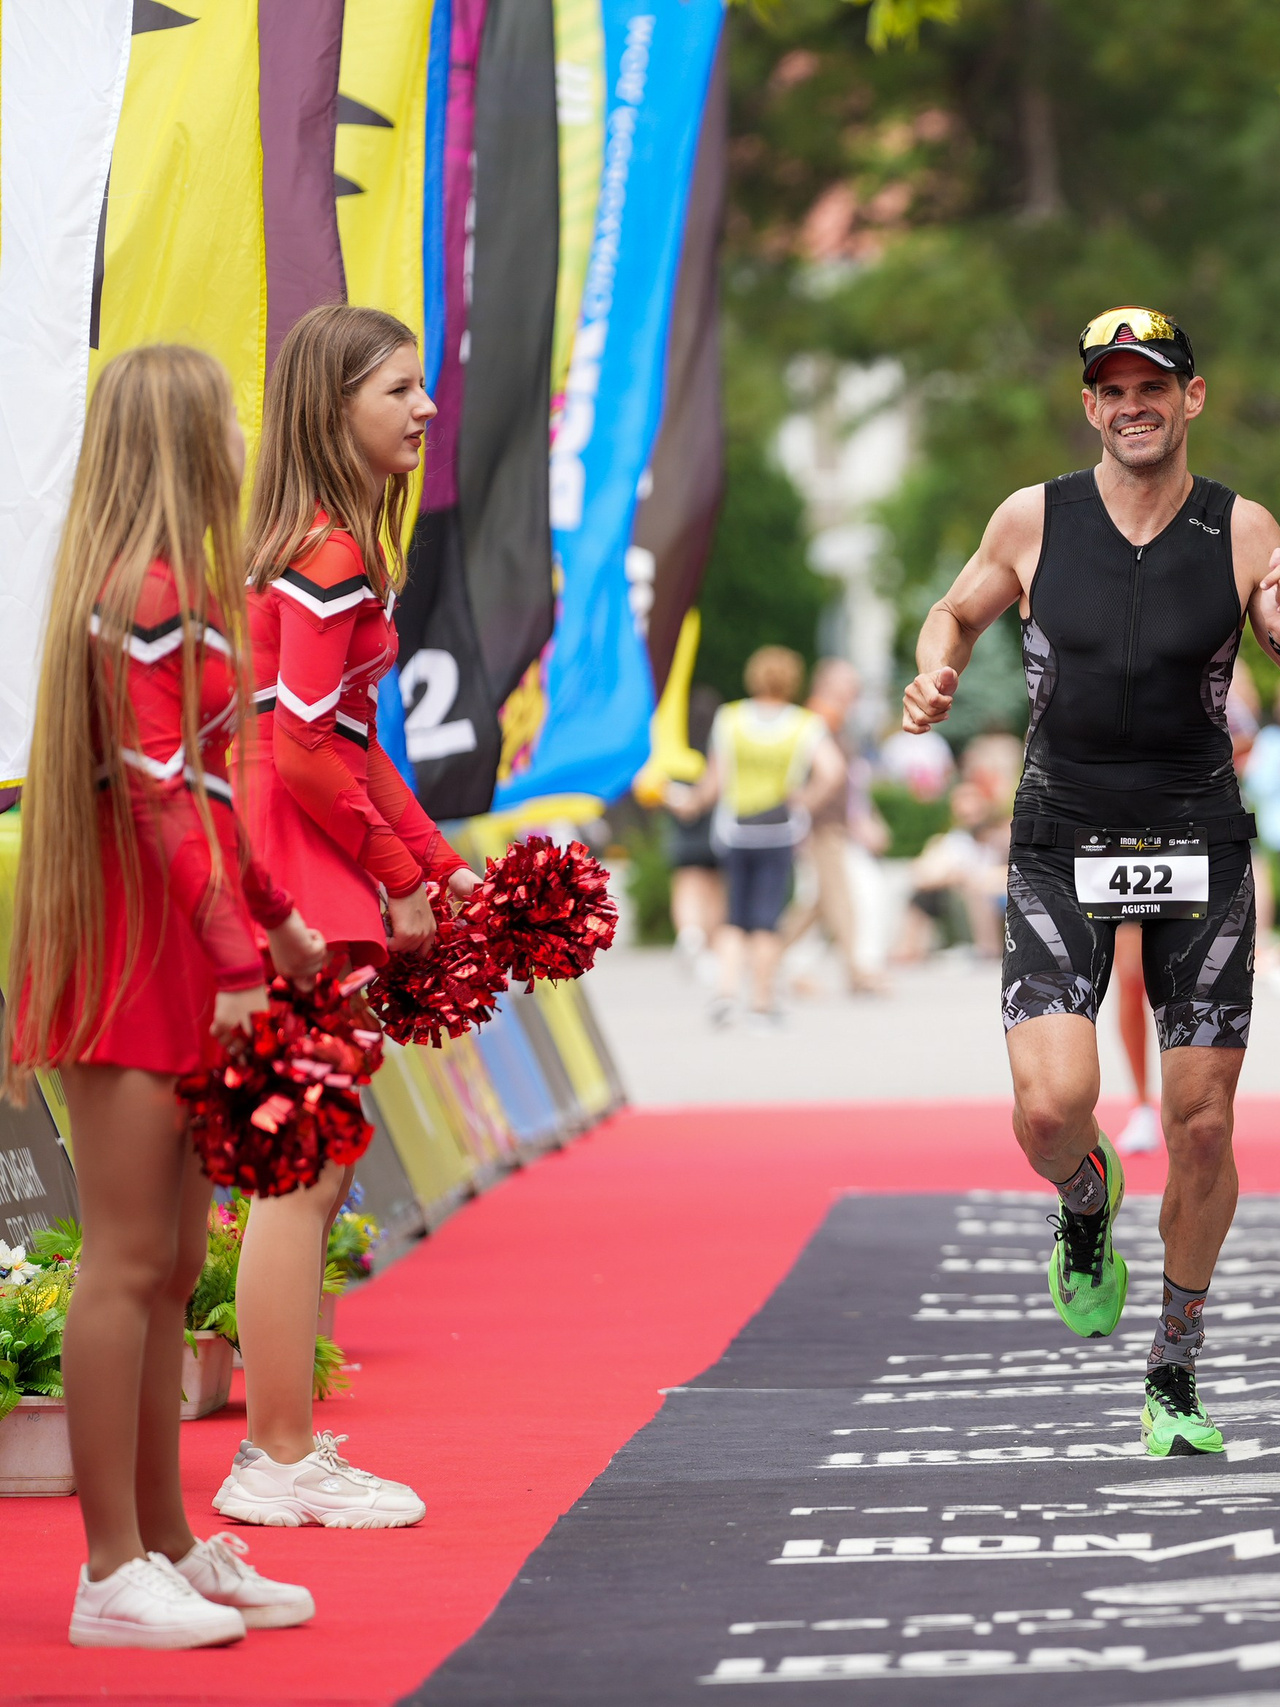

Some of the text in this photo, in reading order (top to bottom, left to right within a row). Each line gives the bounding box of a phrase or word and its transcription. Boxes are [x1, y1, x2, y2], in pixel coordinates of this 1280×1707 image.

[1189, 518, 1220, 535] orca
[1109, 864, 1173, 895] 422
[1121, 904, 1161, 914] AGUSTIN
[829, 1441, 1149, 1464] IRON
[781, 1533, 1153, 1557] IRON
[714, 1646, 1145, 1679] IRON
